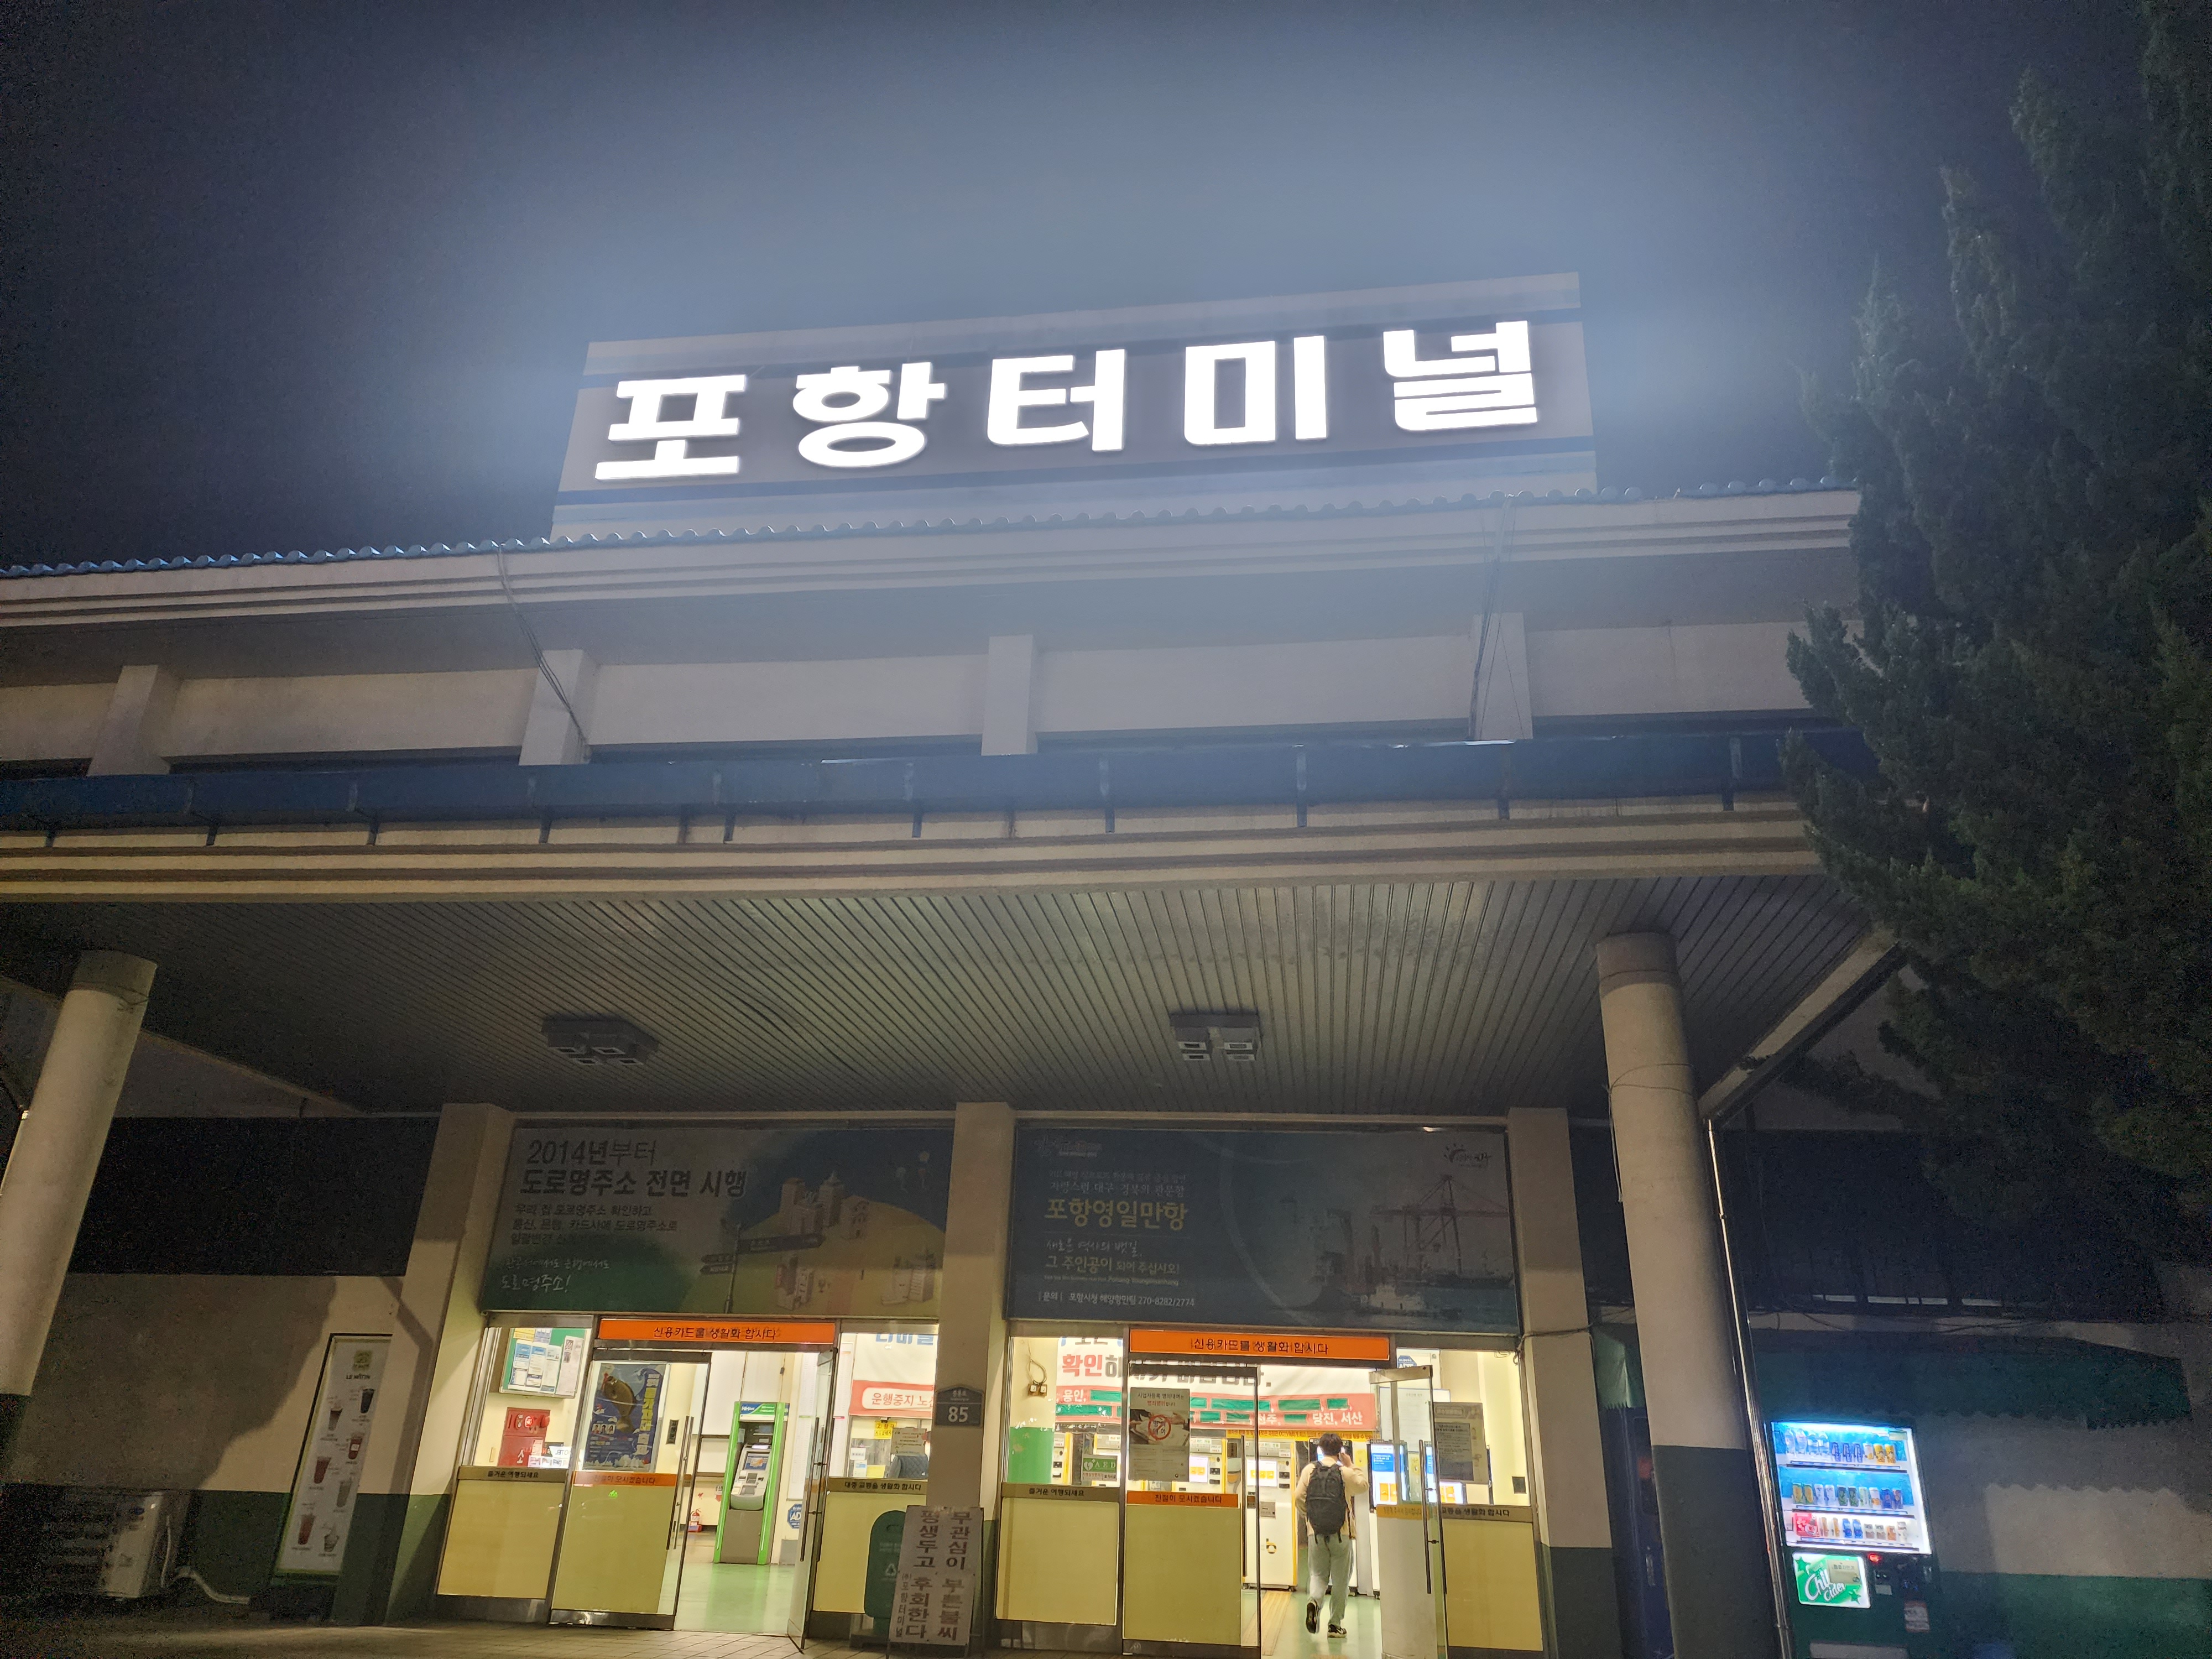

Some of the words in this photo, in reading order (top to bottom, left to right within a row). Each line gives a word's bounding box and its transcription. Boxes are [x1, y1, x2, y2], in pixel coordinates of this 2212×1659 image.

[594, 319, 1538, 480] 포항터미널
[527, 1139, 656, 1166] 2014년부터
[520, 1169, 637, 1196] 도로명주소
[646, 1170, 691, 1197] 전면
[699, 1171, 747, 1197] 시행
[1094, 1182, 1114, 1193] 대구
[555, 1204, 606, 1217] 도로명주소
[611, 1204, 652, 1217] 확인하고
[1045, 1198, 1188, 1231] 포항영일만항
[1046, 1238, 1074, 1253] 새로운
[1045, 1256, 1058, 1268] 그
[1062, 1256, 1113, 1274] 주인공이
[1117, 1262, 1135, 1272] 되어
[1069, 1292, 1098, 1305] 포항시청
[1139, 1297, 1194, 1307] 270-8282/2774
[654, 1327, 705, 1338] 신용카드를
[710, 1328, 742, 1339] 생활화
[745, 1329, 776, 1340] 합시다
[1194, 1338, 1250, 1352] 신용카드를
[1255, 1340, 1289, 1353] 생활화
[1294, 1342, 1328, 1354] 합시다
[872, 1392, 914, 1407] 운행중지
[948, 1406, 968, 1422] 85
[1313, 1412, 1338, 1426] 당진,
[1341, 1412, 1363, 1426] 서산
[880, 1482, 900, 1490] 생활화
[902, 1483, 921, 1491] 합시다
[1051, 1488, 1084, 1496] 여행되세요
[1463, 1507, 1485, 1516] 생활화
[1488, 1508, 1510, 1517] 합시다
[946, 1511, 972, 1570] 무관심이
[905, 1577, 933, 1639] 후회한다
